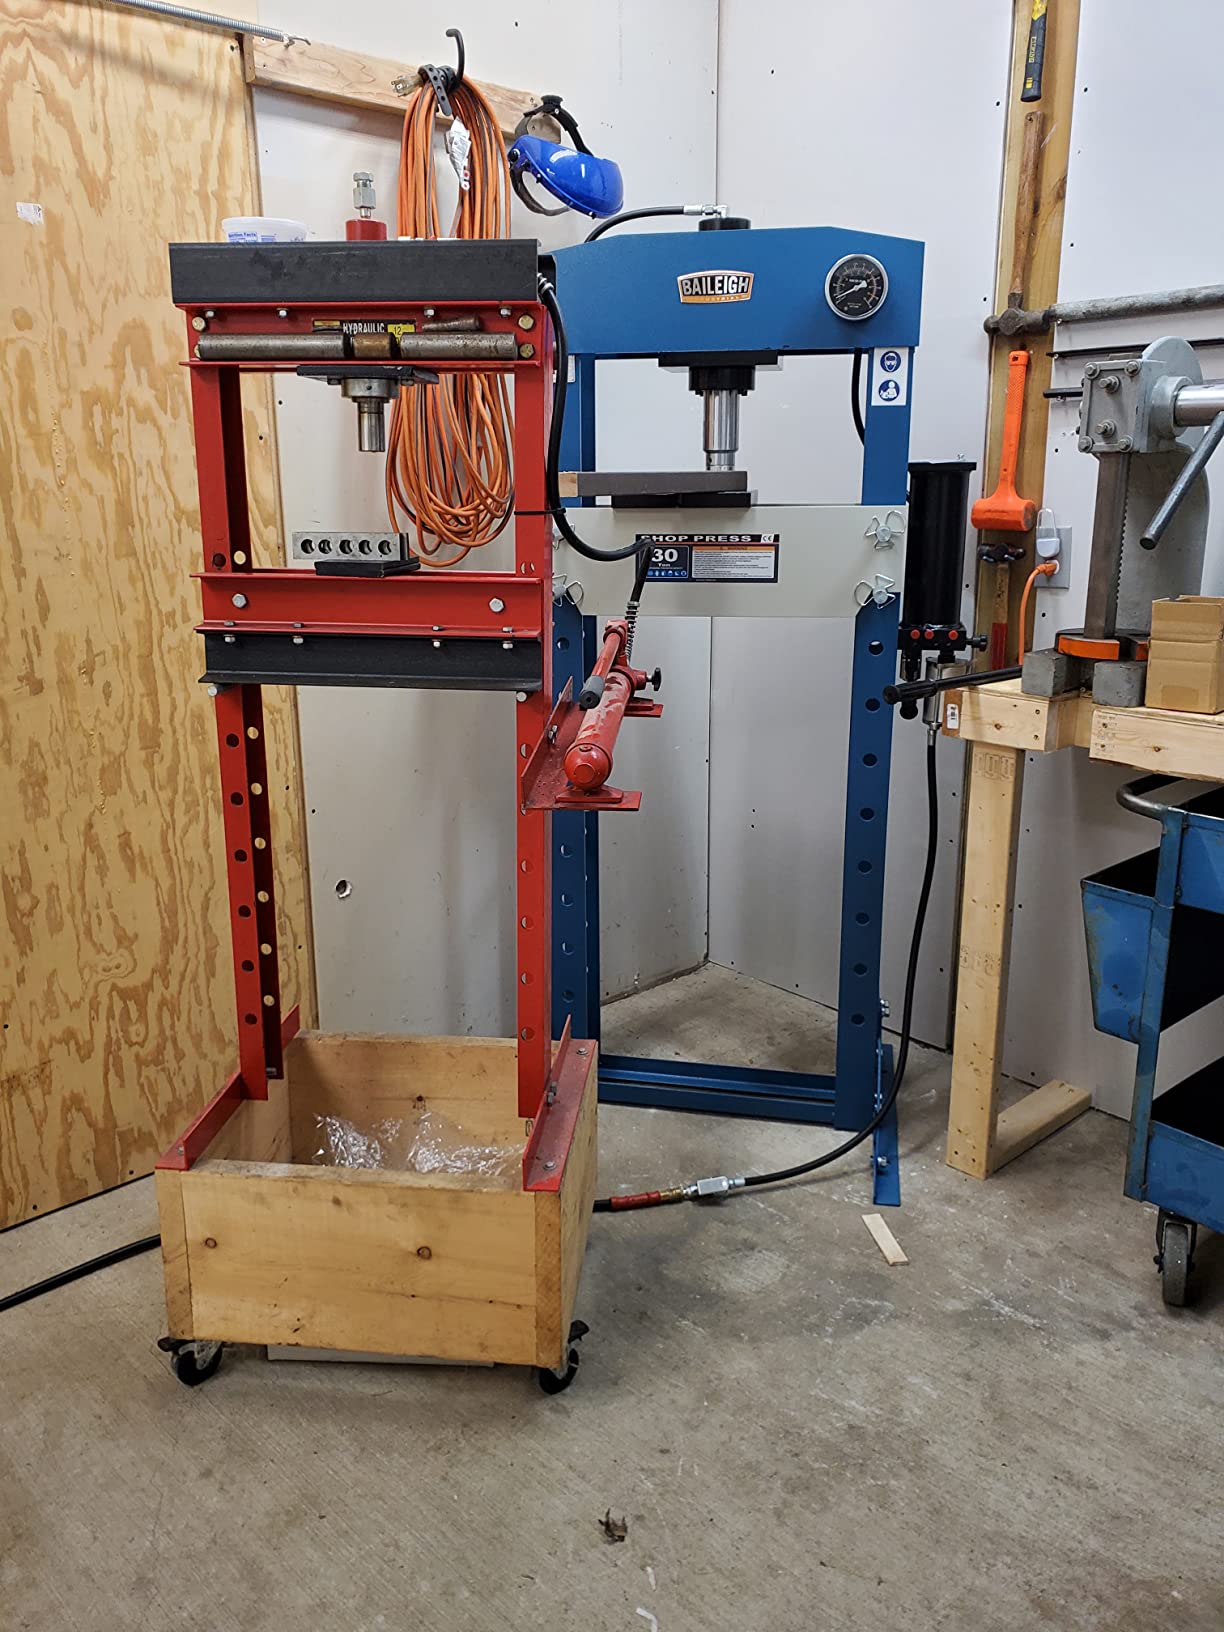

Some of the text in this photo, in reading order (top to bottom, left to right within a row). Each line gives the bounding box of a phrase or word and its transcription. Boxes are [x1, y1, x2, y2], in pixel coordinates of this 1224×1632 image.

[682, 275, 749, 295] BAILEIGH
[343, 322, 385, 334] HYDRAULIC
[393, 326, 402, 336] 12
[652, 548, 678, 562] 30
